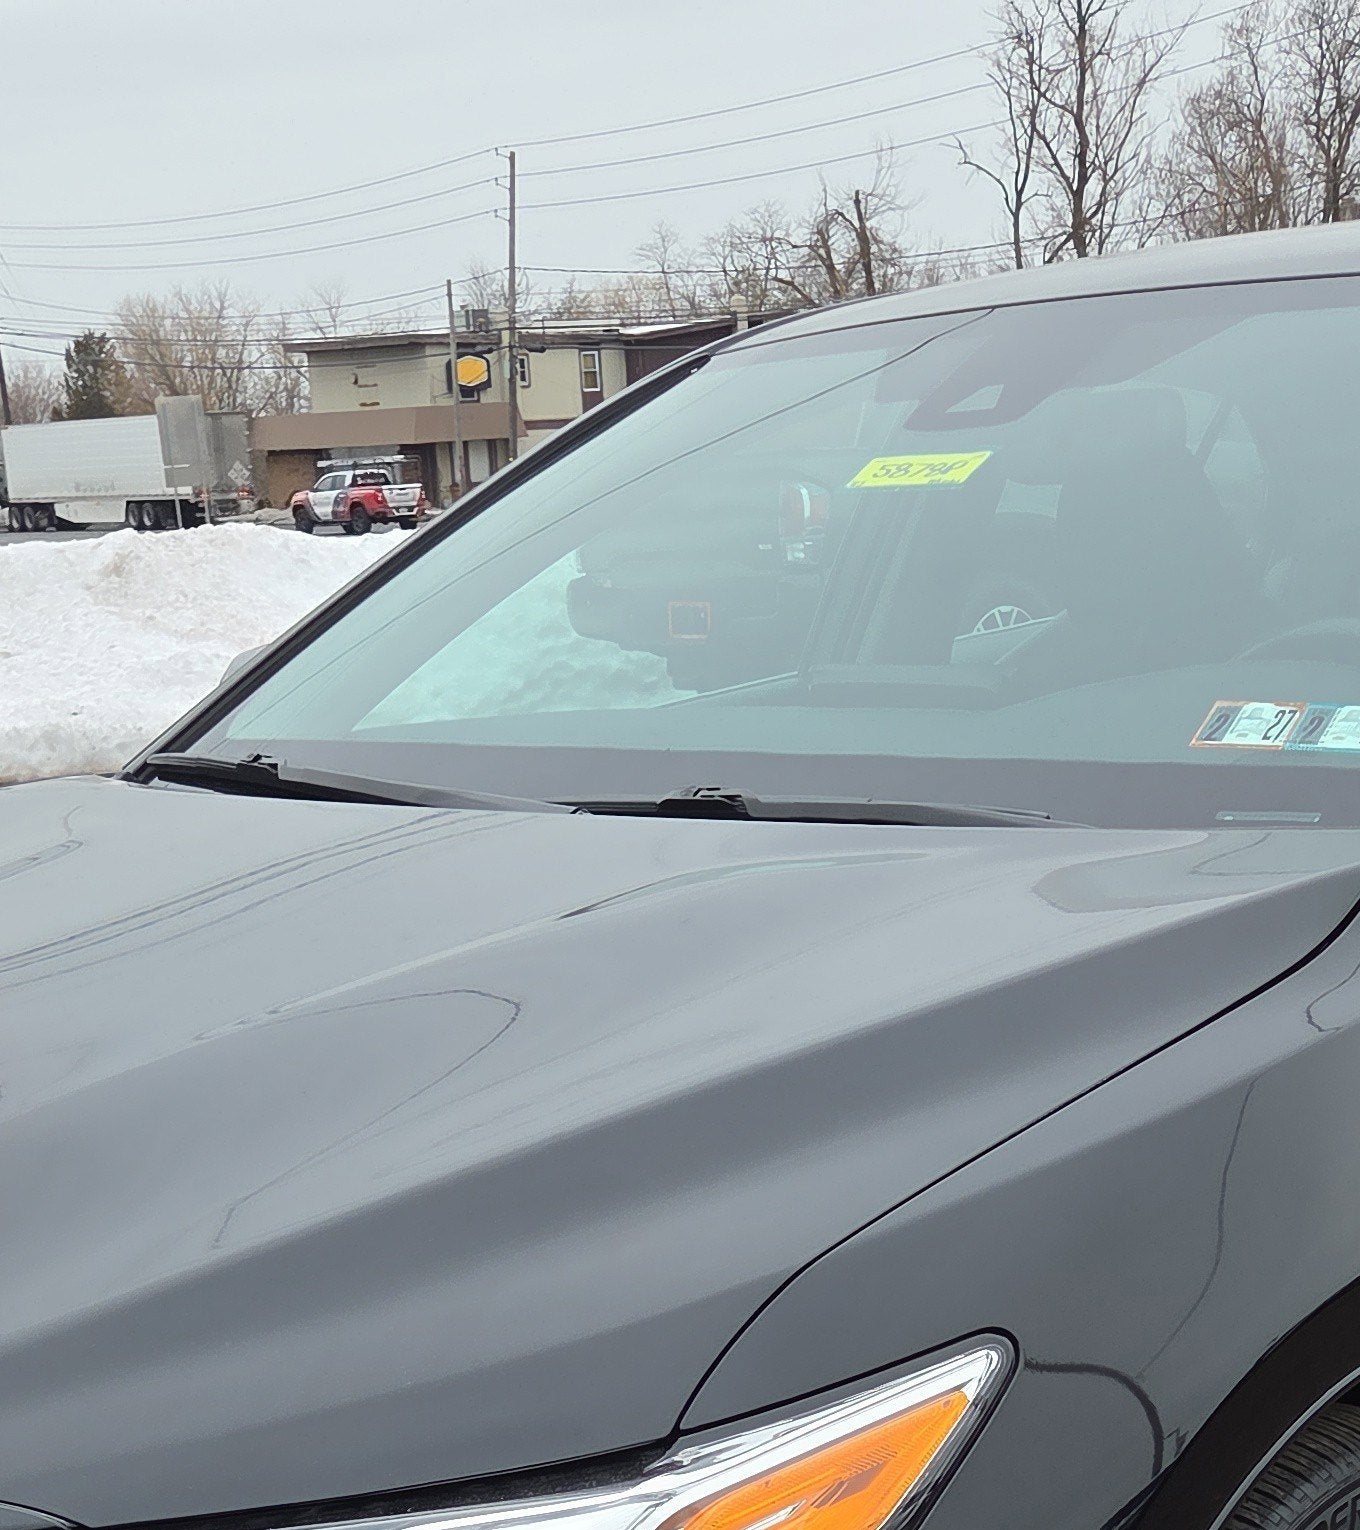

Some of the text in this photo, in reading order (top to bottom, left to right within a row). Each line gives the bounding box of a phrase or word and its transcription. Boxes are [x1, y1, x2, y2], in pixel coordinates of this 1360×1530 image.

[1204, 709, 1299, 743] 2 27
[1302, 715, 1325, 744] 2
